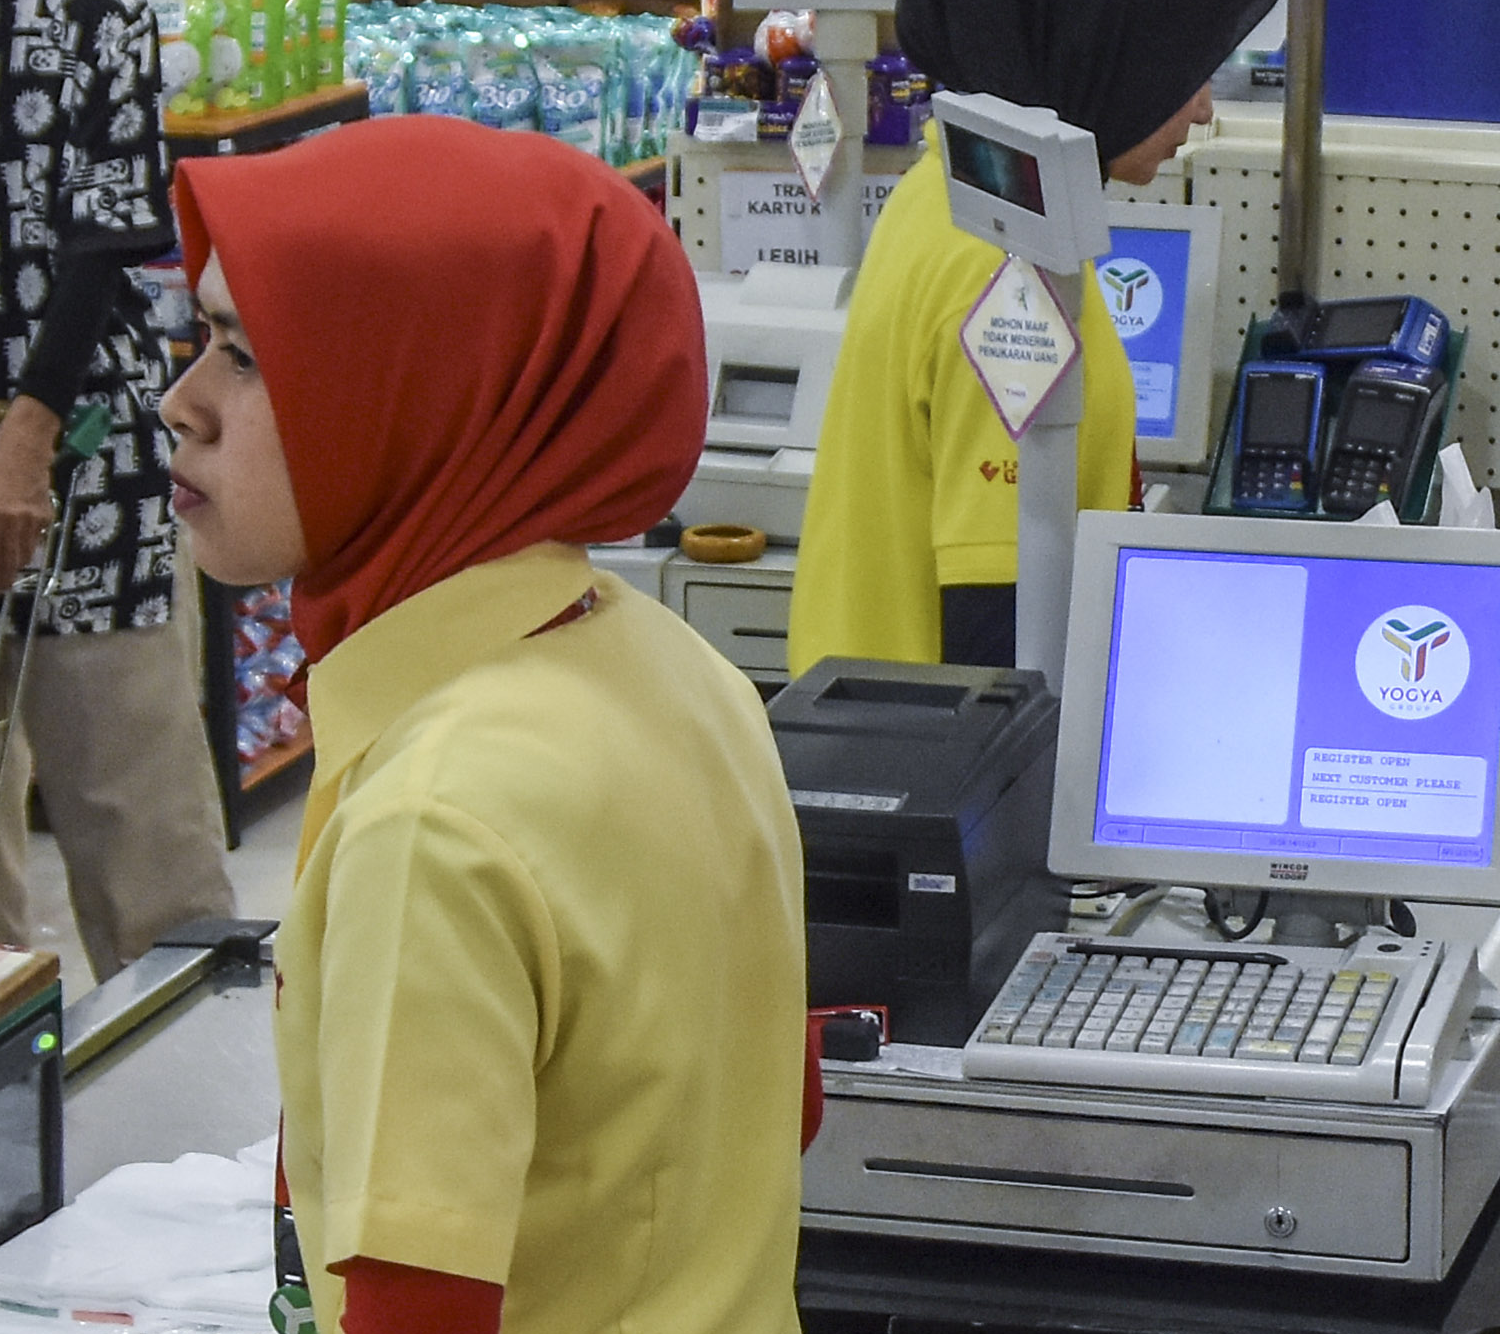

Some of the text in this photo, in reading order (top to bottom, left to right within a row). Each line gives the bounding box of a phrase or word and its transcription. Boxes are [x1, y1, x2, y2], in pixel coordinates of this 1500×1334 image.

[747, 201, 806, 216] KARTU
[758, 248, 820, 266] LEBIH
[990, 316, 1050, 333] MOHON MAAF
[1111, 314, 1145, 327] OGYA
[983, 330, 1056, 349] TIDAK MENERIMA
[978, 345, 1059, 365] PENUKARAN UANG
[1378, 685, 1444, 705] YOGYA
[1312, 752, 1411, 769] REGISTER OPEN
[1311, 771, 1462, 791] NEXT CUSTOMER PLEASE
[1309, 793, 1408, 810] REGISTER OPEN
